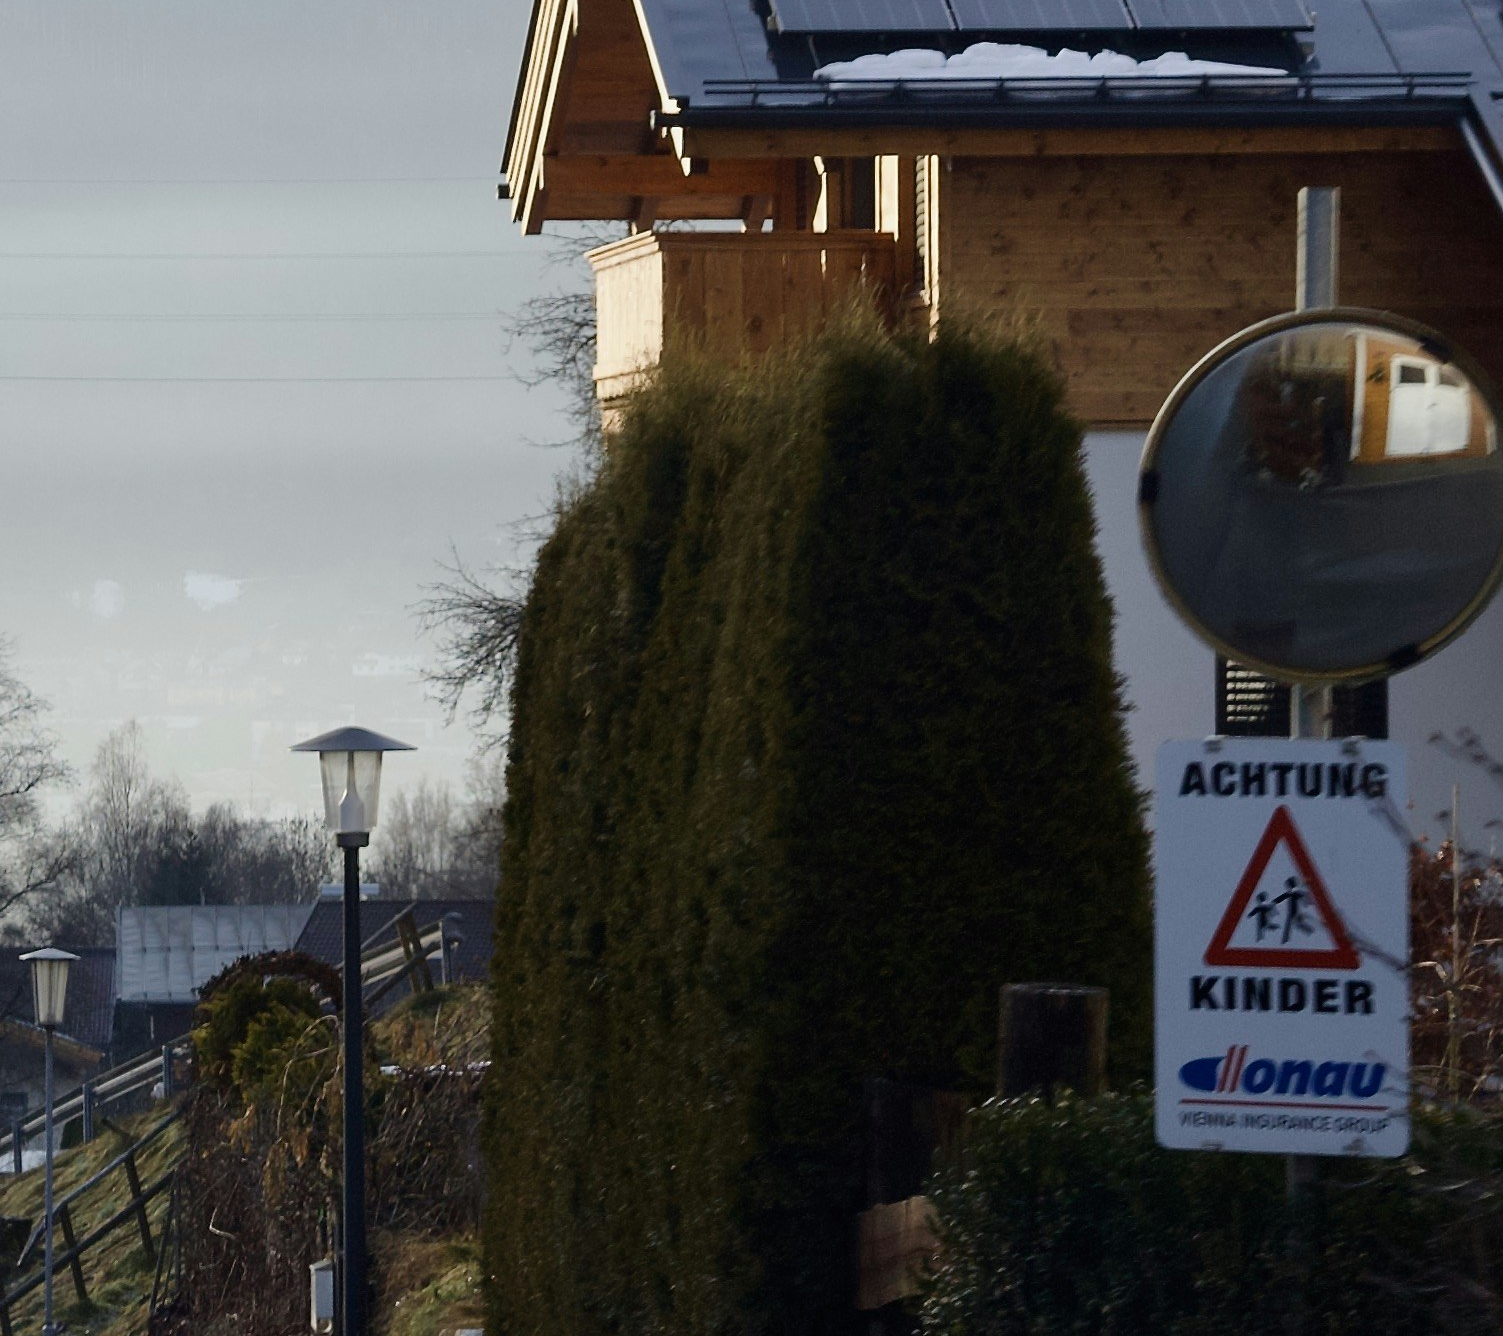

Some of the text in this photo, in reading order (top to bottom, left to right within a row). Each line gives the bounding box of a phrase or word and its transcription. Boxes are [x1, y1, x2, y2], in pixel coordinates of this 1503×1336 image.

[1179, 762, 1389, 797] ACHTUNG
[1189, 975, 1375, 1014] KINDER
[1178, 1111, 1389, 1134] VIENNA INSURANCE GROUP
